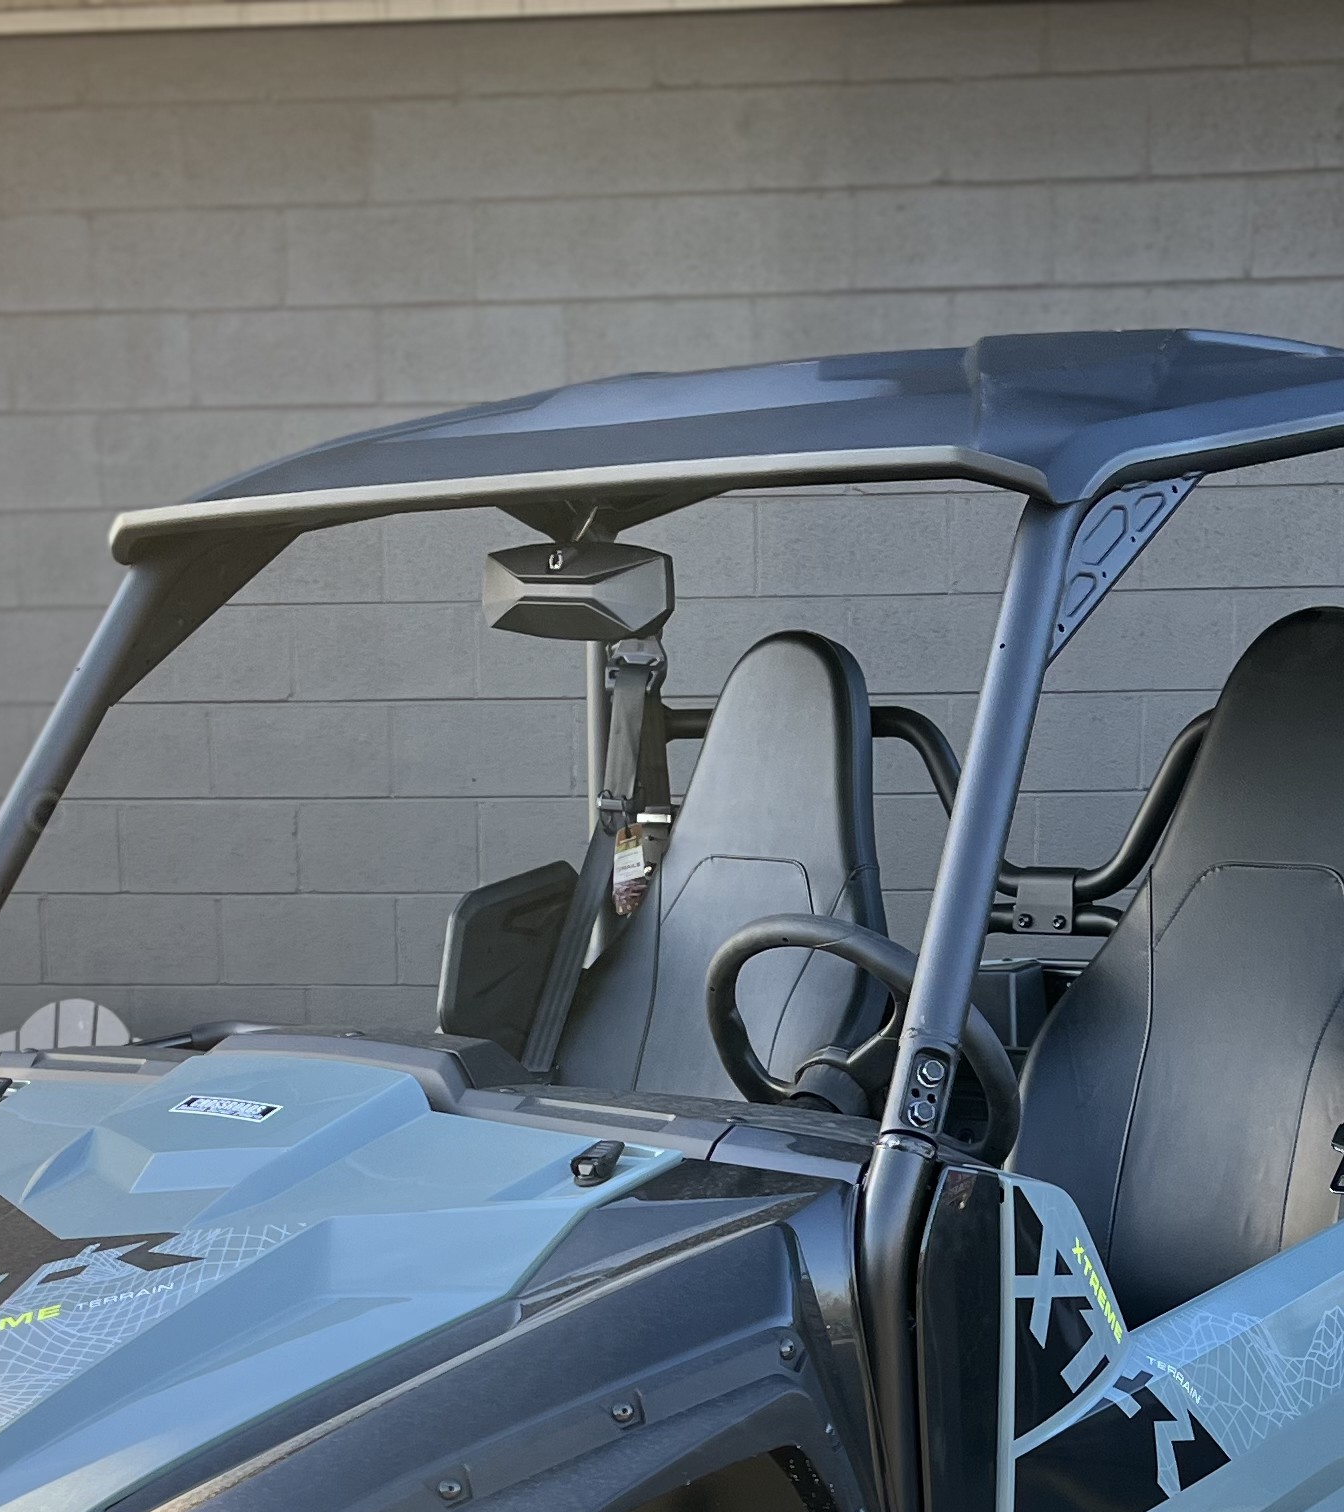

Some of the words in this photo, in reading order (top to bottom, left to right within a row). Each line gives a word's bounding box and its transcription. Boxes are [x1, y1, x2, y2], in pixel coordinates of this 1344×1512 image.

[76, 1282, 175, 1312] TERRAIN
[1071, 1236, 1124, 1344] XTREME
[1146, 1355, 1203, 1405] TERRAIN
